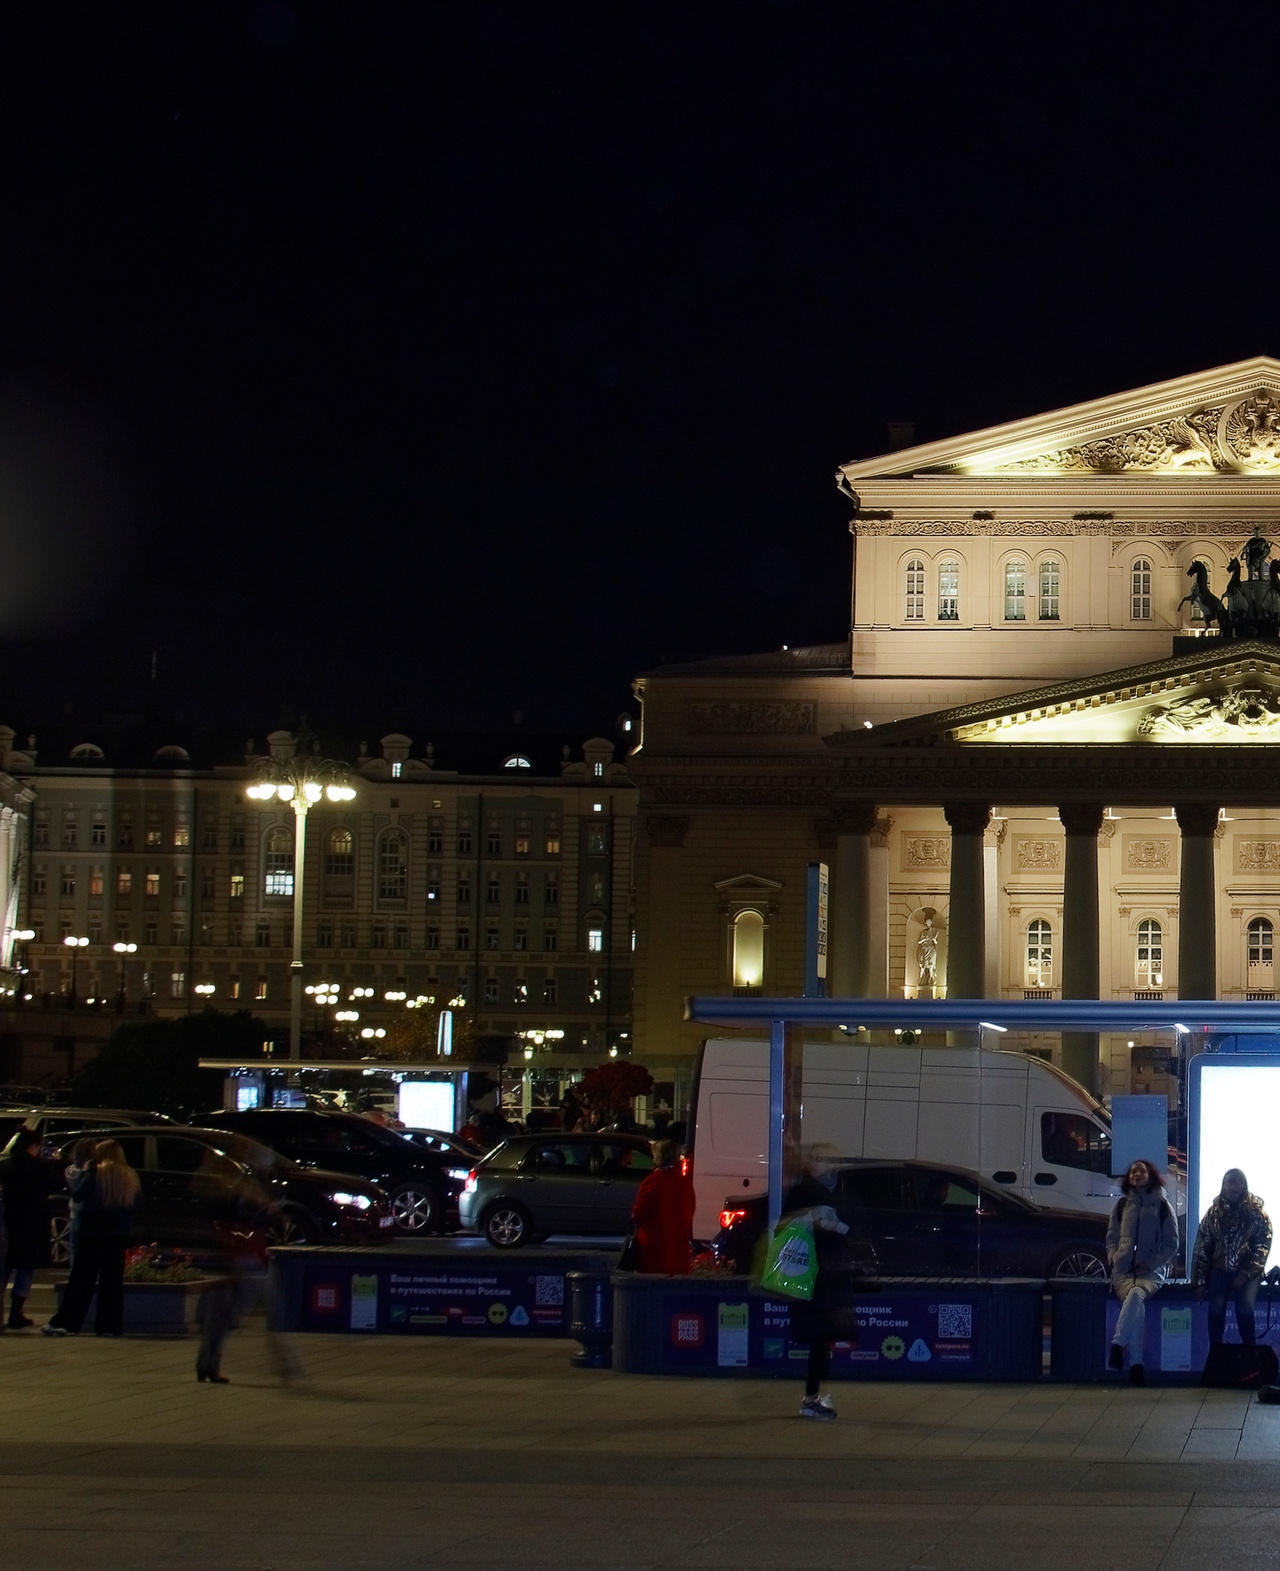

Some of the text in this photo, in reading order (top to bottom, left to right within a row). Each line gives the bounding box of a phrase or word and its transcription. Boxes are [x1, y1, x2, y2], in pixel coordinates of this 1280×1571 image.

[478, 1287, 512, 1296] России
[763, 1302, 788, 1312] Ваш
[678, 1319, 698, 1330] RUSS
[763, 1317, 770, 1326] в
[868, 1316, 909, 1328] России
[678, 1330, 698, 1341] PASS
